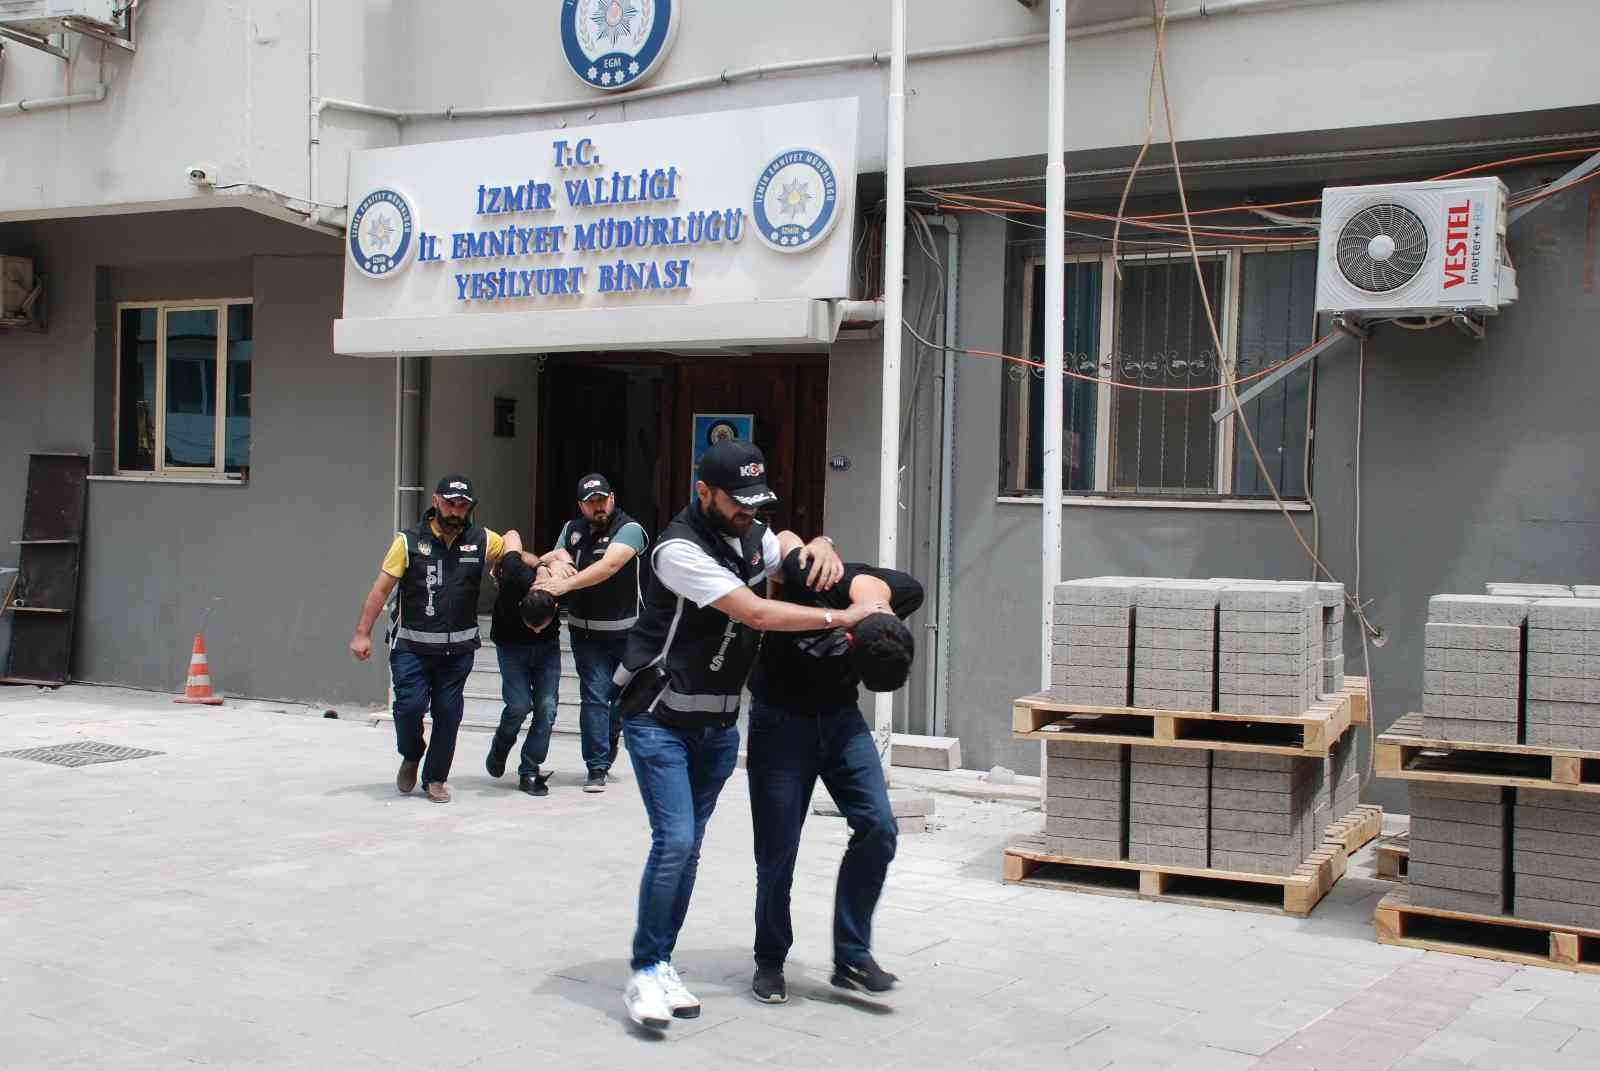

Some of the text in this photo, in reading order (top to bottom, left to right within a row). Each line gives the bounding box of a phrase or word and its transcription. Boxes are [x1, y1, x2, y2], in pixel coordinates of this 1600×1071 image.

[603, 58, 622, 69] EGM
[553, 138, 600, 168] T.C.
[476, 166, 678, 214] İZMİR VALİLİĞİ
[418, 208, 742, 261] İL EMNİYET MÜDÜRLÜĞÜ
[1443, 199, 1470, 289] VESTEL
[455, 259, 690, 300] YEŞİLYURT BİNASI
